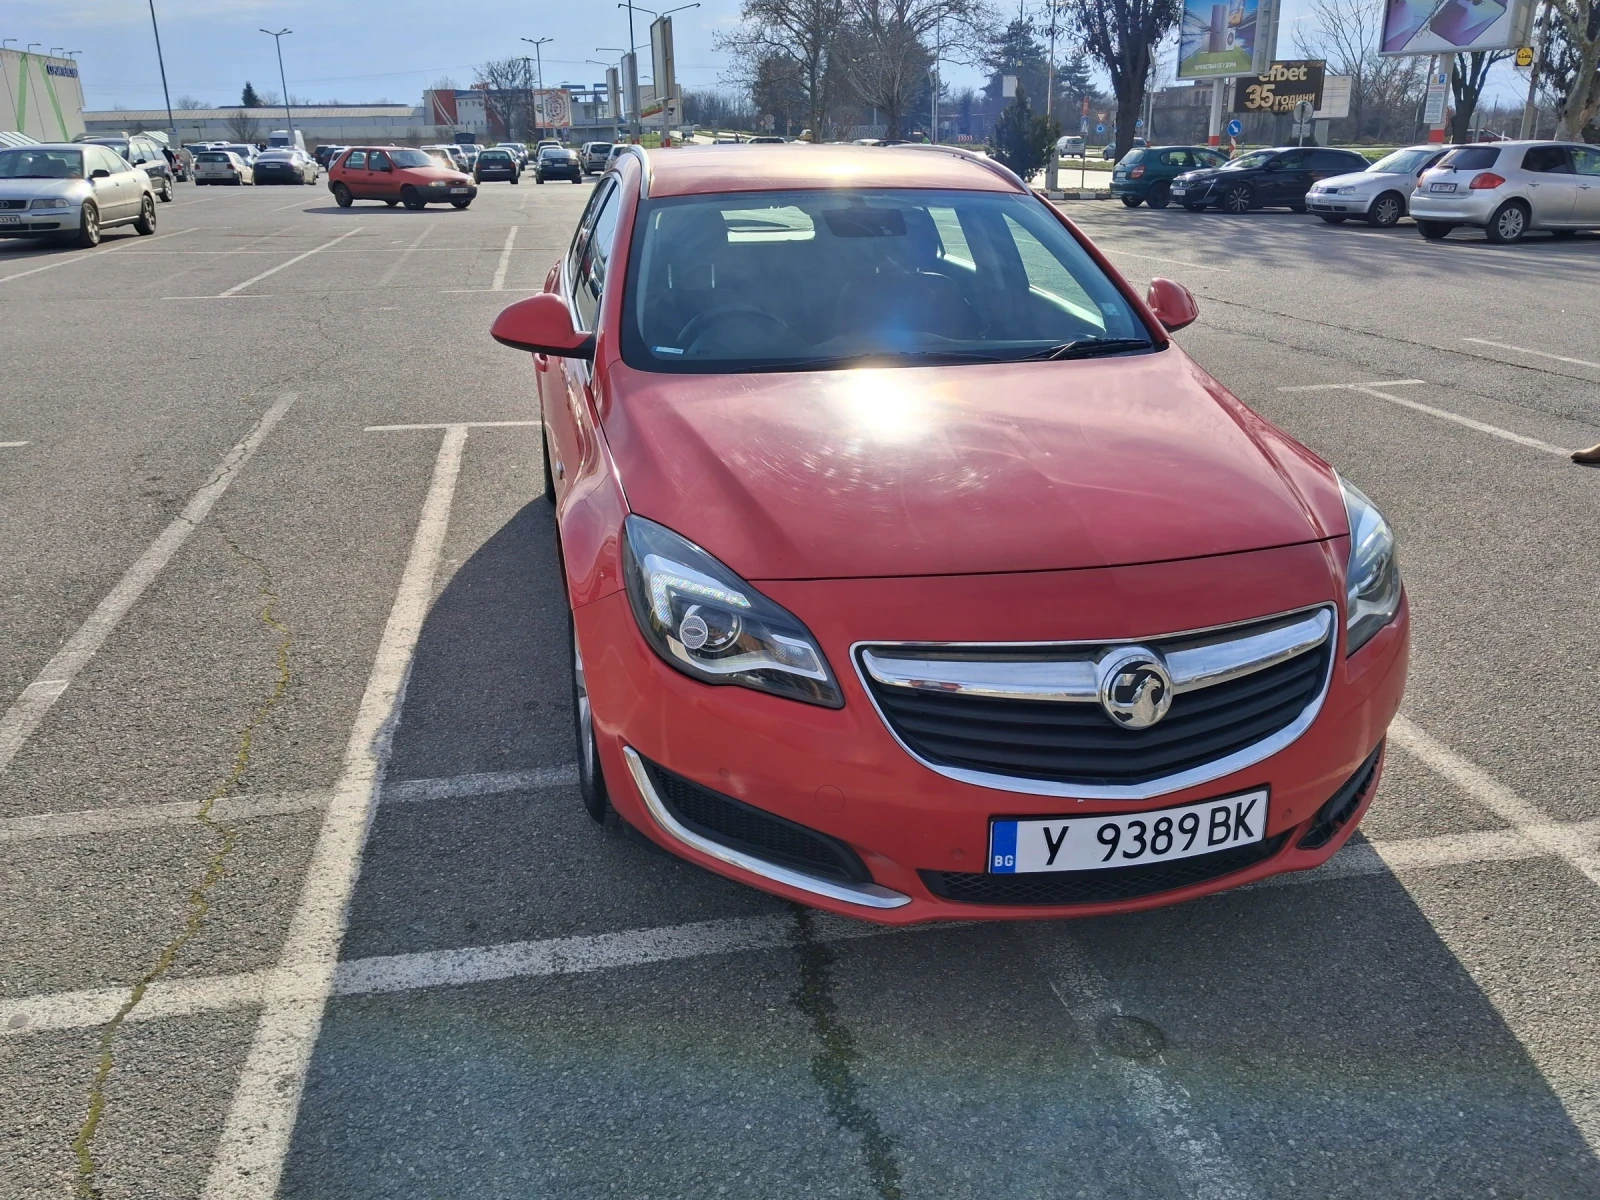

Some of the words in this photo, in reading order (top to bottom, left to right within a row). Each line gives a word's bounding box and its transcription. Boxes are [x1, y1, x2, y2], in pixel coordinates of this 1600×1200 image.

[1244, 84, 1275, 108] 35
[1042, 826, 1069, 866] Y
[1096, 812, 1201, 862] 9389
[1207, 799, 1258, 847] BK
[994, 854, 1014, 867] BG
